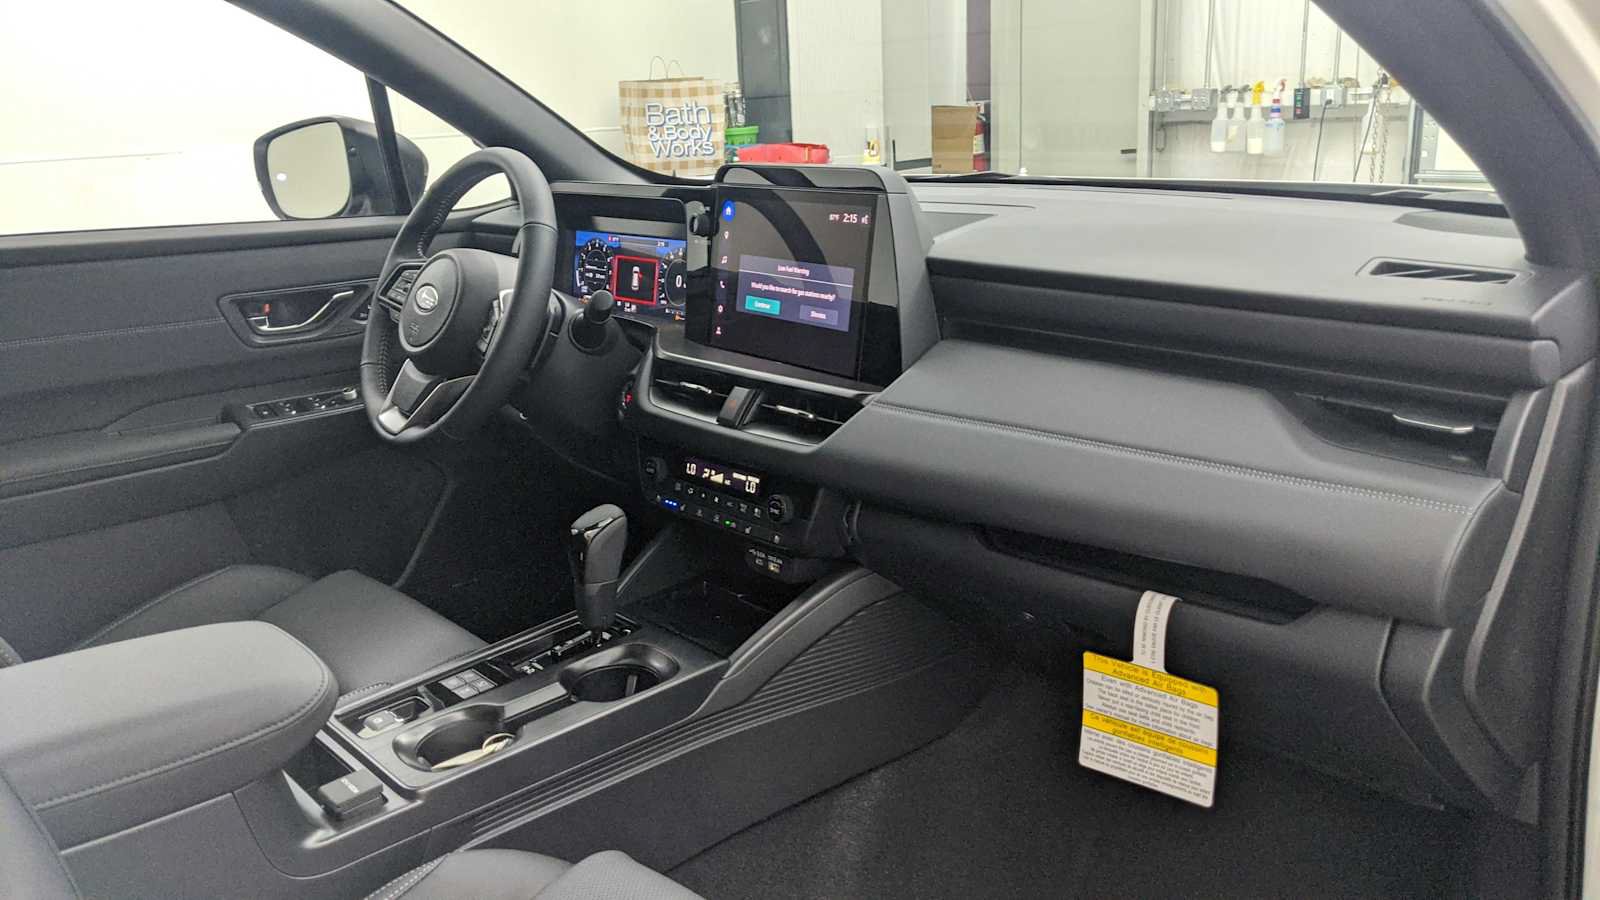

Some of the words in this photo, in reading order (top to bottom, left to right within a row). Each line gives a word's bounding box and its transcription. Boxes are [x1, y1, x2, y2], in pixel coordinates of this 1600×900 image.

[645, 100, 712, 126] Bath
[648, 126, 661, 141] &
[664, 124, 712, 142] Body
[650, 139, 716, 159] Works
[842, 213, 858, 224] 2:15
[676, 274, 682, 288] 0
[1112, 668, 1149, 684] Advanced
[1152, 679, 1163, 688] Air
[1166, 683, 1186, 696] Bags
[1151, 672, 1188, 689] Equipped
